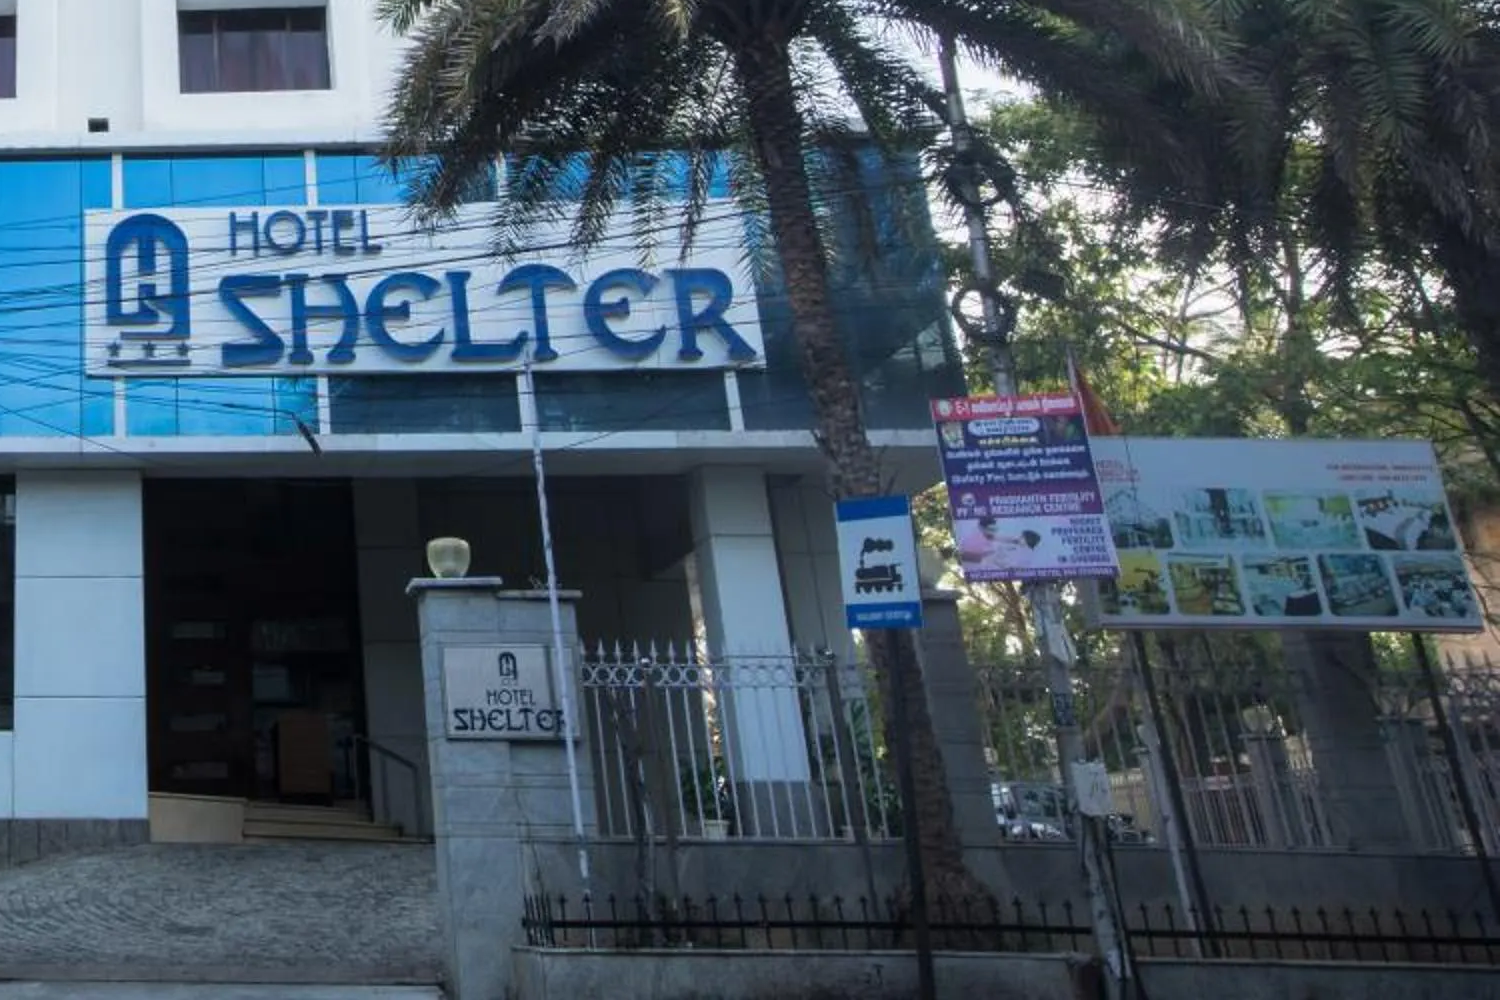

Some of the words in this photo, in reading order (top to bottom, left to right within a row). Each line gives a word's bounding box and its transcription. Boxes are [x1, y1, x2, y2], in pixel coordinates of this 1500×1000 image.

[229, 209, 382, 257] HOTEL
[218, 262, 758, 367] SHELTER
[486, 689, 536, 706] HOTEL
